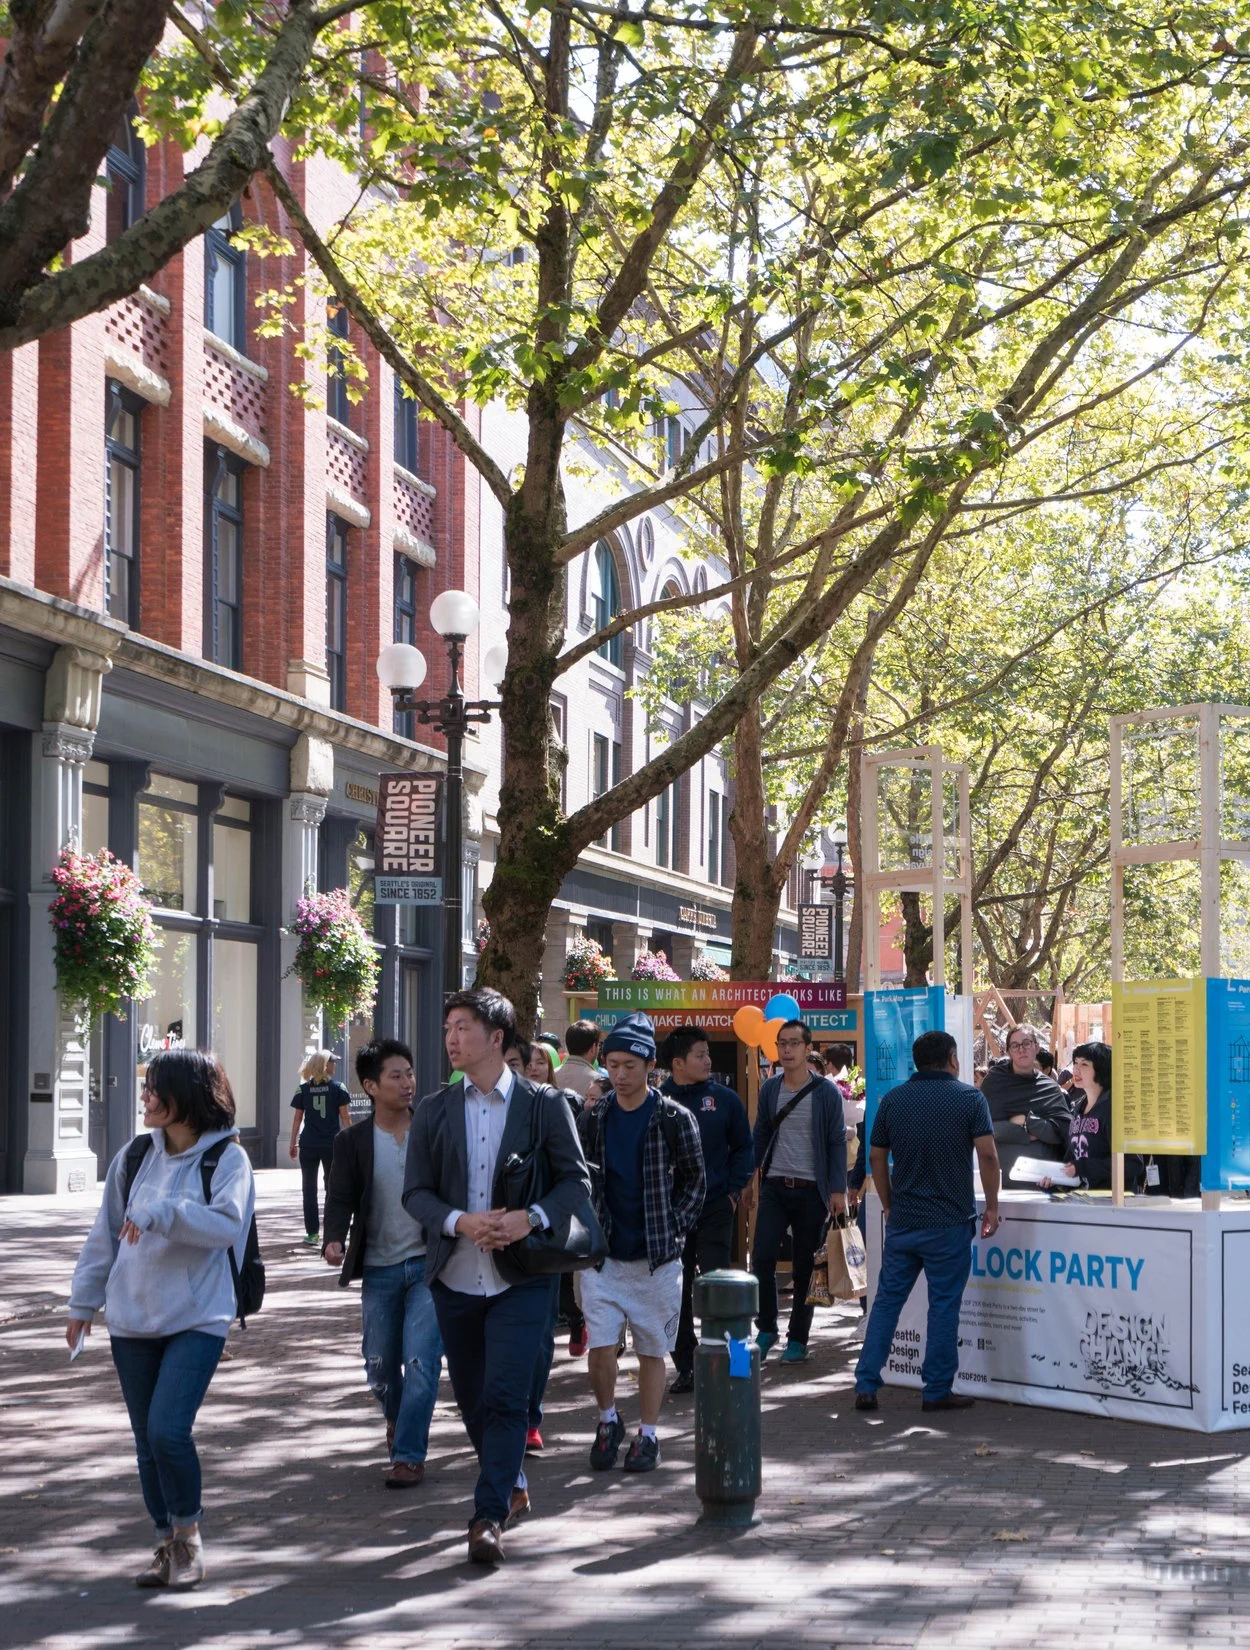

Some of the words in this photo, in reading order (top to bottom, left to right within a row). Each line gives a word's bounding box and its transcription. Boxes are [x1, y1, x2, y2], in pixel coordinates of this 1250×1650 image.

[383, 781, 411, 871] SQUARE
[409, 780, 436, 872] PIONEER
[380, 888, 410, 899] SINCE
[412, 888, 437, 899] 1852
[802, 907, 815, 956] SQUARE
[816, 908, 829, 956] PIONEER
[605, 988, 632, 1000] THIS
[638, 988, 649, 1000] IS
[655, 988, 686, 1000] WHAT
[691, 988, 706, 1000] AN
[711, 988, 773, 1001] ARCHITECT
[818, 989, 842, 1001] LIKE
[595, 1014, 617, 1026] CHILD
[650, 1015, 682, 1026] MAKE
[685, 1015, 694, 1026] A
[695, 1015, 734, 1026] MATCH
[312, 1095, 326, 1119] 4
[972, 1245, 1043, 1283] LOCK
[1050, 1251, 1145, 1291] PARTY
[895, 1329, 920, 1342] eattle
[889, 1343, 920, 1360] Design
[889, 1360, 922, 1375] Festiva
[958, 1372, 987, 1382] #SDF2016
